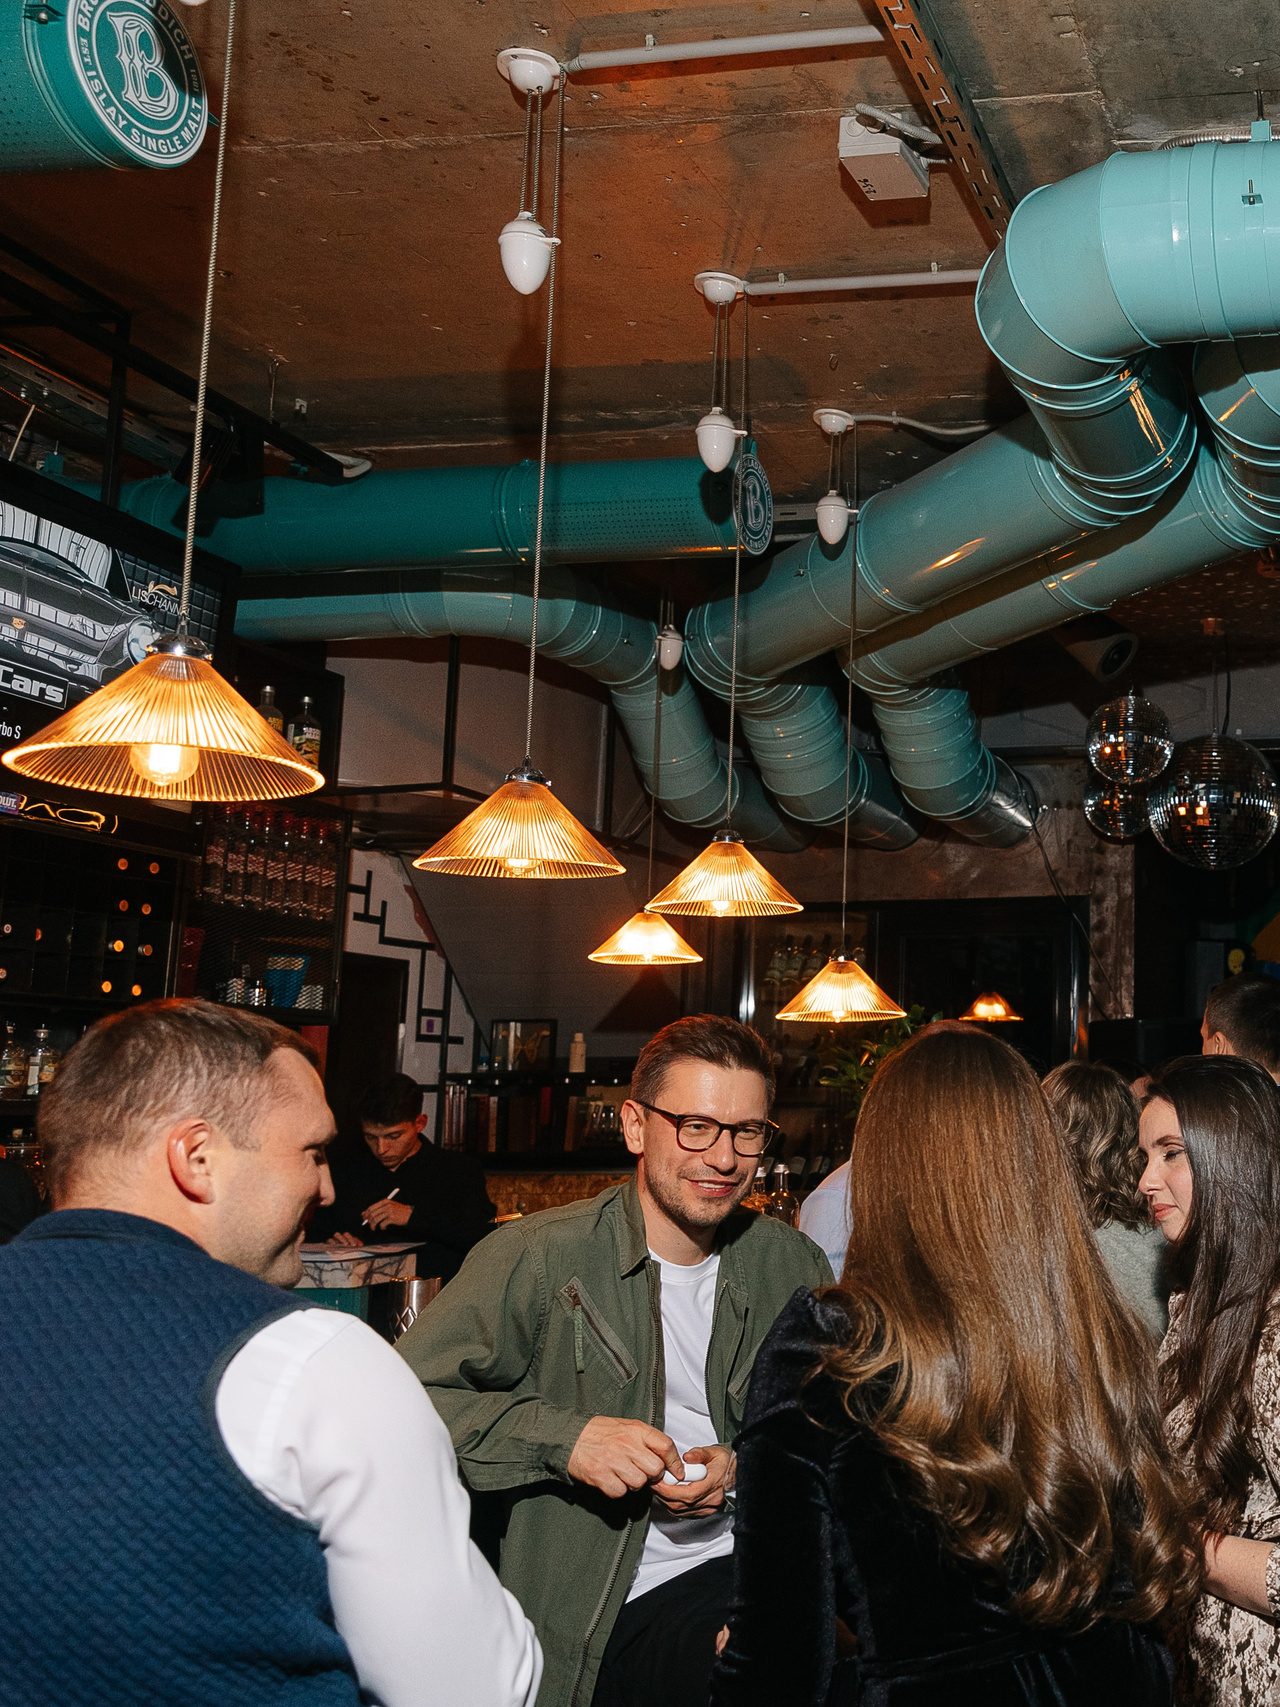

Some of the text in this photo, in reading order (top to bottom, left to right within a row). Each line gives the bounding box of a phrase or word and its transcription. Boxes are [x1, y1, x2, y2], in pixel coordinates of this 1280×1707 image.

[81, 37, 92, 66] EST
[106, 11, 179, 121] B
[87, 69, 203, 154] ISLAY SINGLE MALT
[742, 475, 764, 532] B
[749, 537, 766, 549] SINGLE
[131, 585, 190, 617] LISCHANNL
[0, 664, 64, 703] Cars
[14, 725, 22, 740] S
